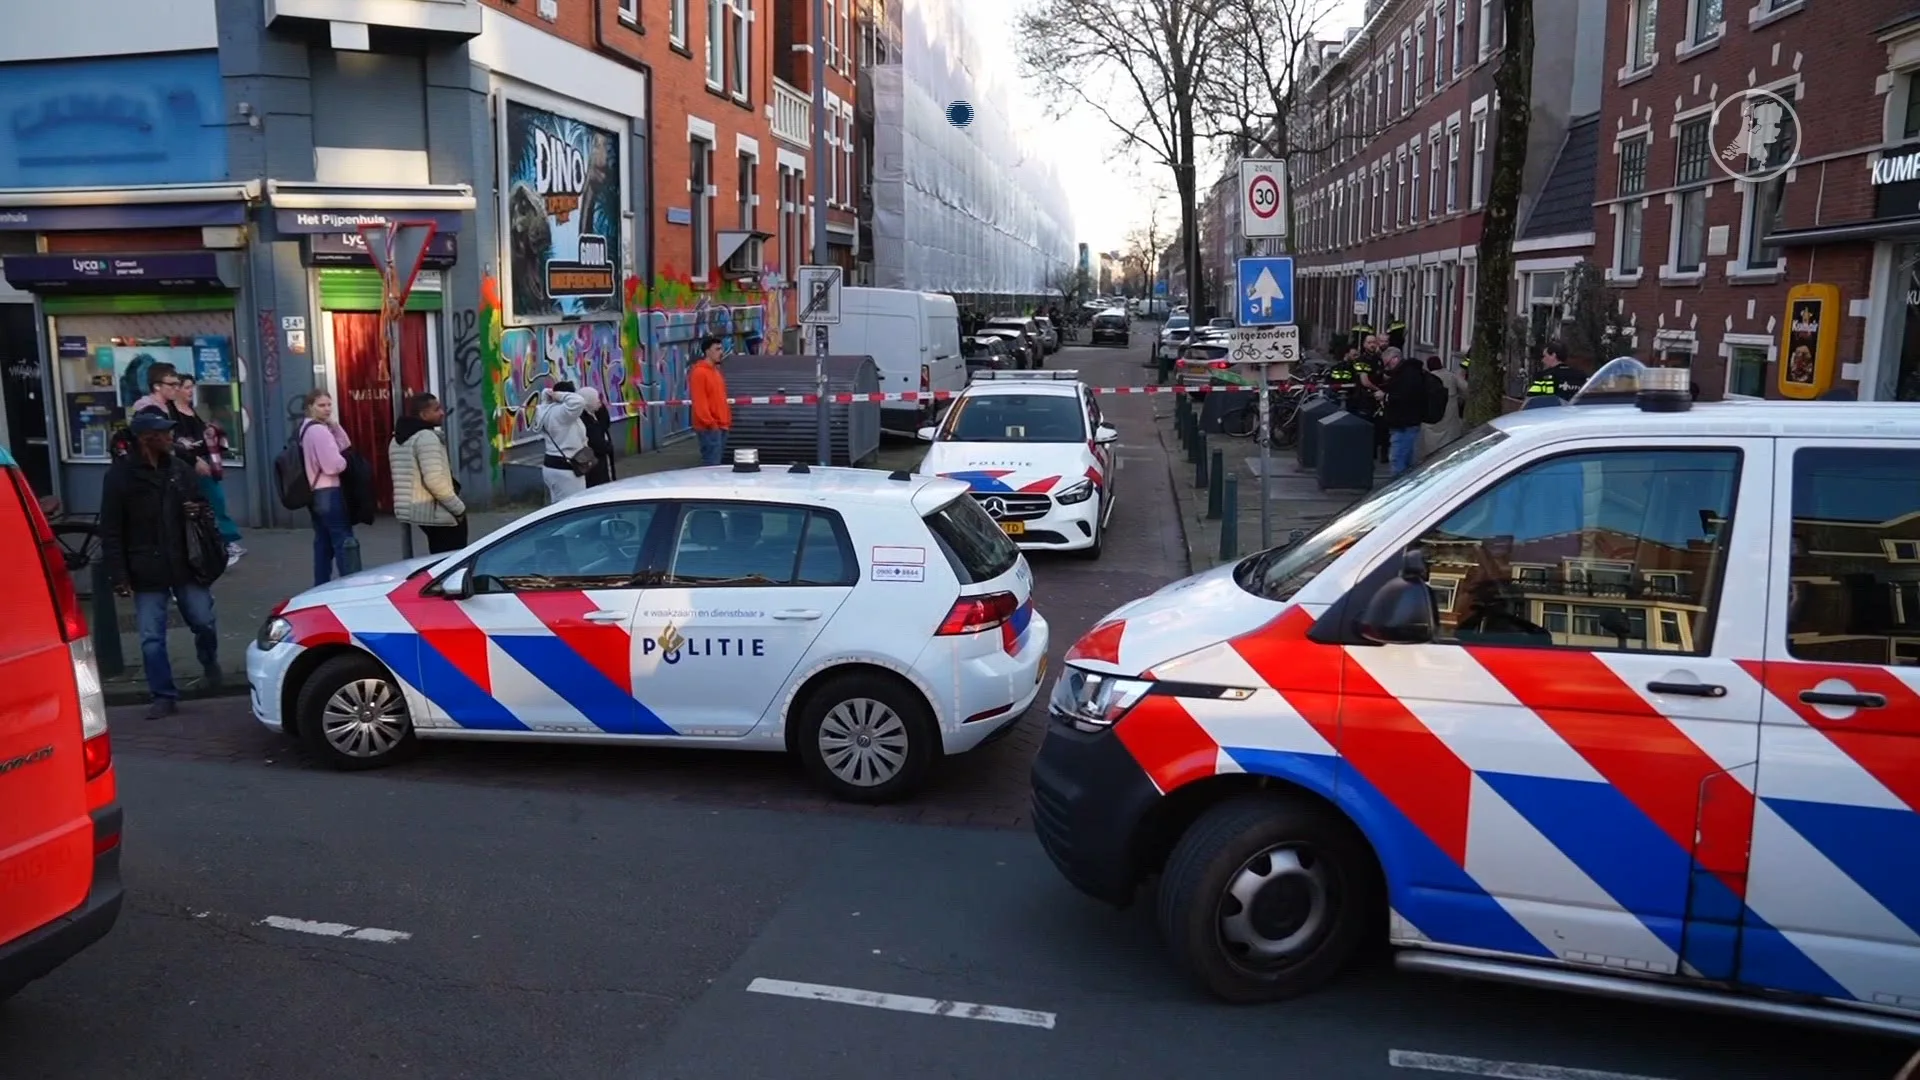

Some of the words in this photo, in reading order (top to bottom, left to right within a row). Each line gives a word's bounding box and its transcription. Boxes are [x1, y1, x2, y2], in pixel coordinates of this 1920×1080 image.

[535, 128, 585, 193] DINO
[1254, 164, 1273, 173] ZONE
[1255, 188, 1275, 205] 30
[298, 214, 319, 225] Het
[72, 258, 99, 273] Lyca
[1230, 330, 1296, 341] uitgezonderd
[650, 609, 697, 618] waakzaam
[710, 608, 757, 618] dienstbaar
[643, 638, 764, 664] POLITIE
